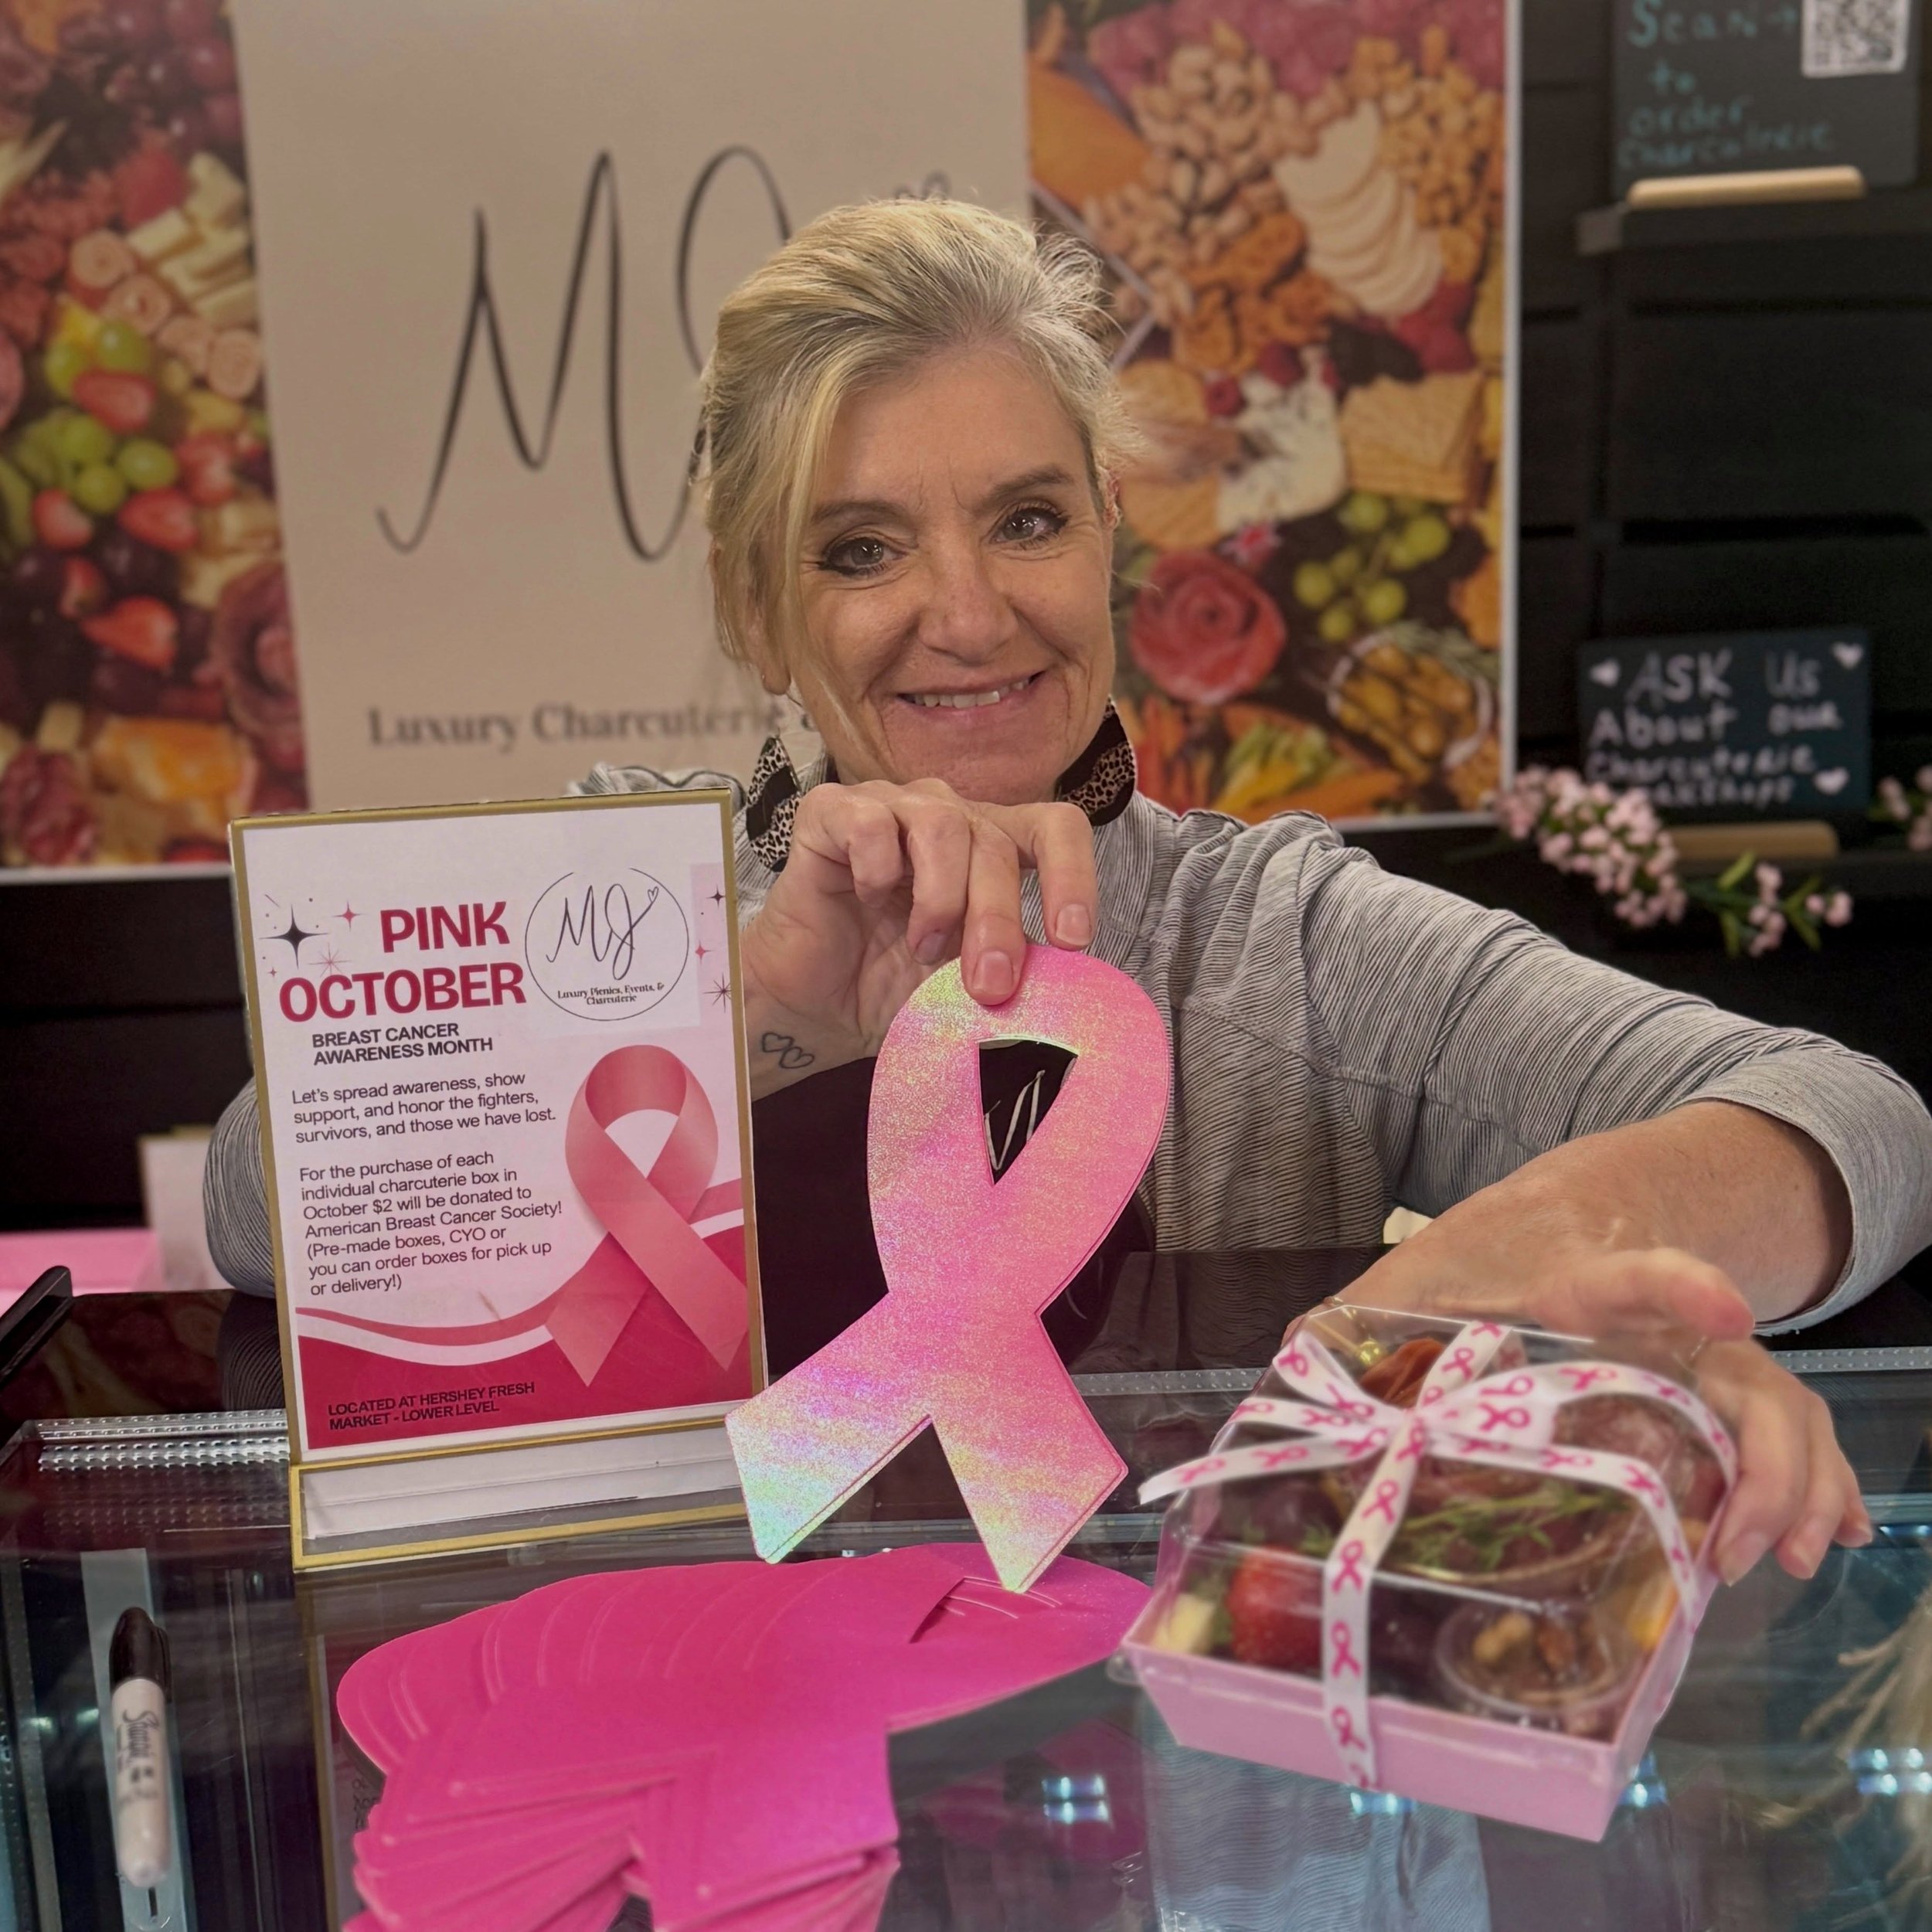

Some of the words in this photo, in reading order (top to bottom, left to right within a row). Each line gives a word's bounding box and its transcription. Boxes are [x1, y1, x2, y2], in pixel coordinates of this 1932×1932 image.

[368, 705, 519, 754] Luxury
[380, 901, 510, 953] PINK
[279, 962, 527, 1022] OCTOBER
[557, 988, 588, 1000] Luxury
[590, 985, 623, 997] Picnics,
[624, 983, 655, 994] Events,
[587, 994, 637, 1005] Charcuterie
[312, 1029, 381, 1048] BREAST
[385, 1022, 459, 1043] CANCER
[313, 1043, 424, 1066] AWARENESS
[427, 1037, 493, 1056] MONTH
[333, 1083, 388, 1103] spread
[393, 1077, 481, 1096] awareness,
[485, 1073, 526, 1088] show
[294, 1107, 360, 1126] support,
[364, 1102, 394, 1117] and
[398, 1099, 444, 1115] honor
[448, 1095, 474, 1111] the
[478, 1091, 539, 1110] fighters,
[295, 1126, 372, 1144] survivors,
[376, 1121, 406, 1136] and
[410, 1116, 454, 1133] those
[457, 1116, 480, 1128] we
[485, 1111, 522, 1126] have
[526, 1107, 556, 1122] lost.
[300, 1167, 326, 1182] For
[329, 1165, 355, 1179] the
[359, 1158, 433, 1180] purchase
[437, 1155, 452, 1169] of
[456, 1151, 495, 1167] each
[301, 1181, 375, 1201] individual
[379, 1173, 467, 1194] charcuterie
[471, 1171, 500, 1185] box
[504, 1168, 517, 1182] in
[303, 1202, 369, 1220] October
[372, 1199, 393, 1215] $2
[396, 1196, 422, 1211] will
[426, 1195, 446, 1209] be
[449, 1188, 513, 1206] donated
[516, 1186, 532, 1199] to
[305, 1219, 381, 1239] American
[386, 1213, 437, 1230] Breast
[440, 1208, 497, 1226] Cancer
[501, 1201, 562, 1220] Society!
[307, 1238, 391, 1261] (Pre-made
[395, 1233, 446, 1249] boxes,
[449, 1226, 486, 1243] CYO
[490, 1226, 507, 1239] or
[308, 1264, 337, 1280] you
[342, 1260, 371, 1274] can
[375, 1254, 418, 1270] order
[422, 1250, 468, 1266] boxes
[471, 1246, 491, 1260] for
[496, 1243, 527, 1261] pick
[532, 1242, 552, 1256] up
[310, 1284, 327, 1296] or
[331, 1274, 402, 1294] delivery!)
[328, 1397, 396, 1417] LOCATED
[398, 1394, 417, 1408] AT
[420, 1387, 486, 1406] HERSHEY
[488, 1382, 535, 1399] FRESH
[329, 1412, 390, 1430] MARKET
[402, 1406, 454, 1423] LOWER
[456, 1400, 500, 1416] LEVEL
